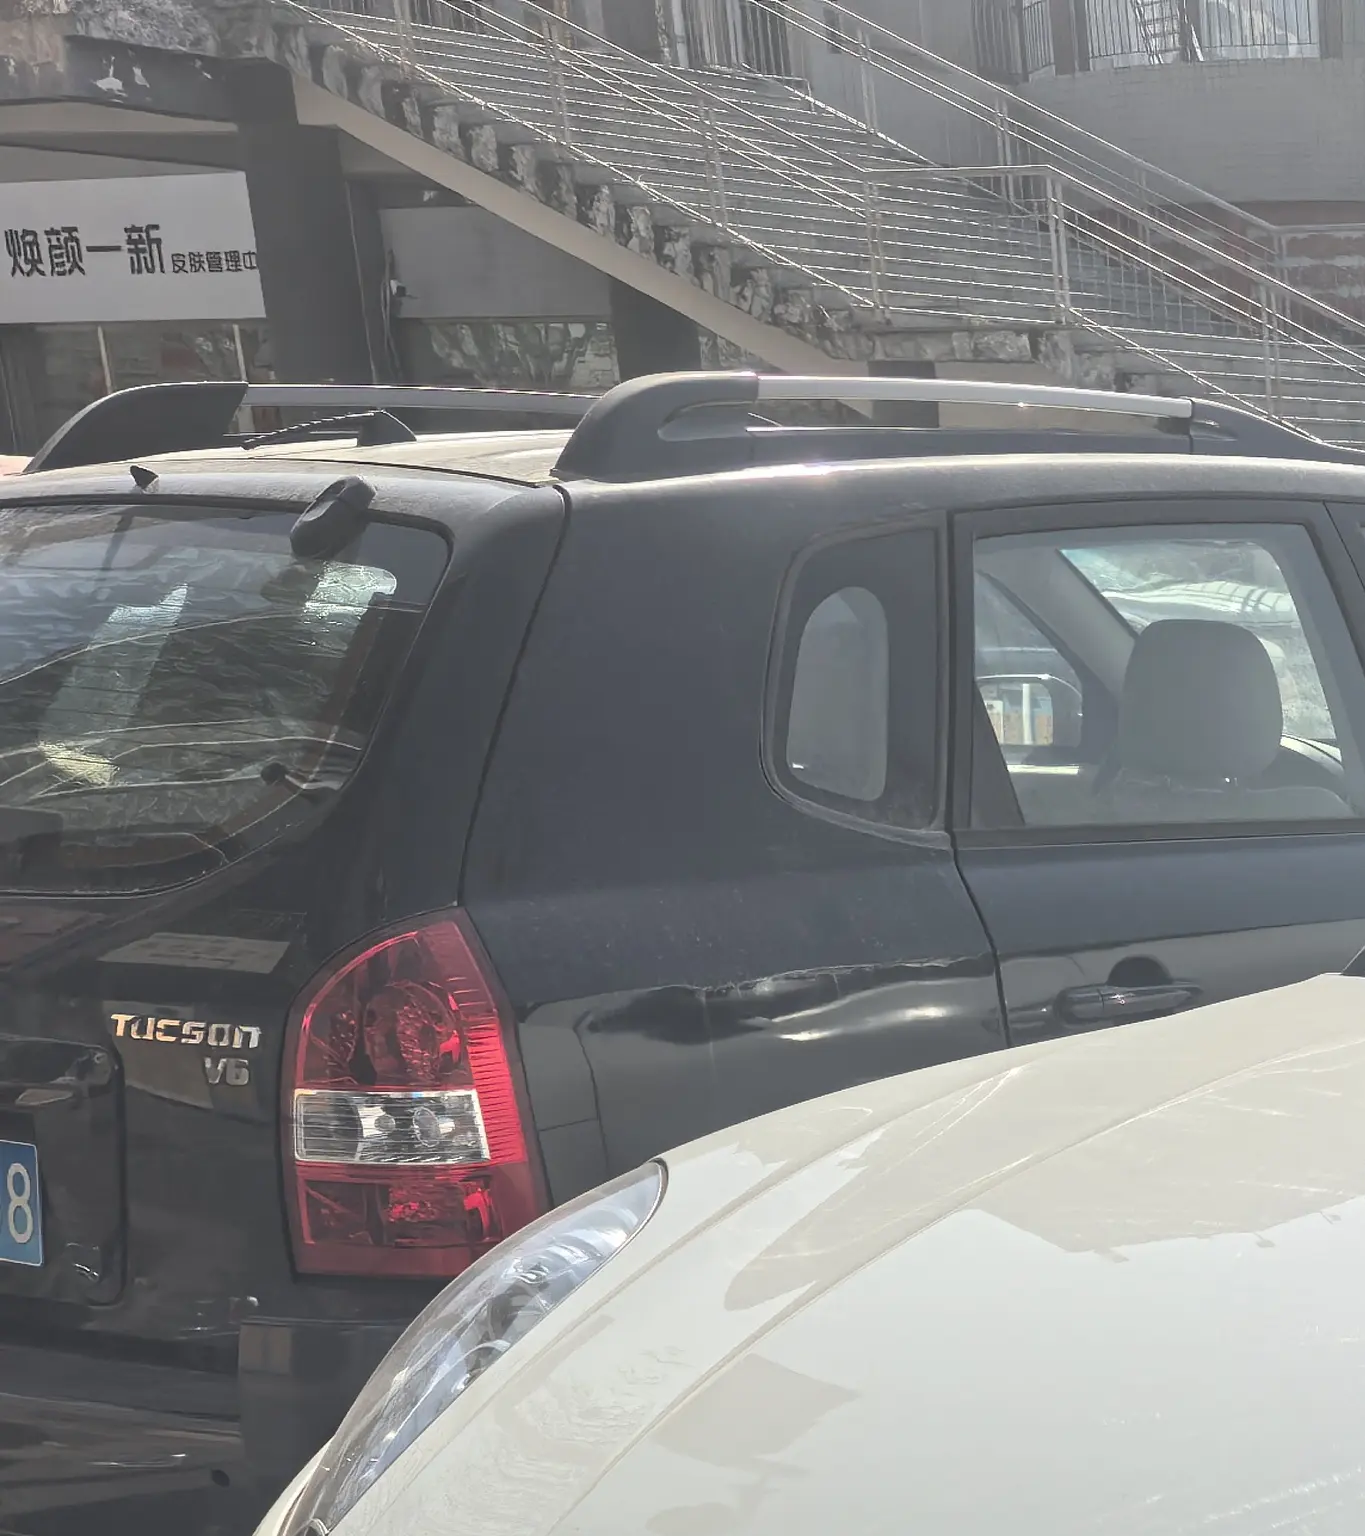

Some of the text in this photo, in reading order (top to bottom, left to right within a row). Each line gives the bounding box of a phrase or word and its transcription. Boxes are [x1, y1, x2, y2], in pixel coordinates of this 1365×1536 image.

[4, 224, 257, 278] 焕颜一新 皮肤管理中
[204, 1057, 250, 1086] V6
